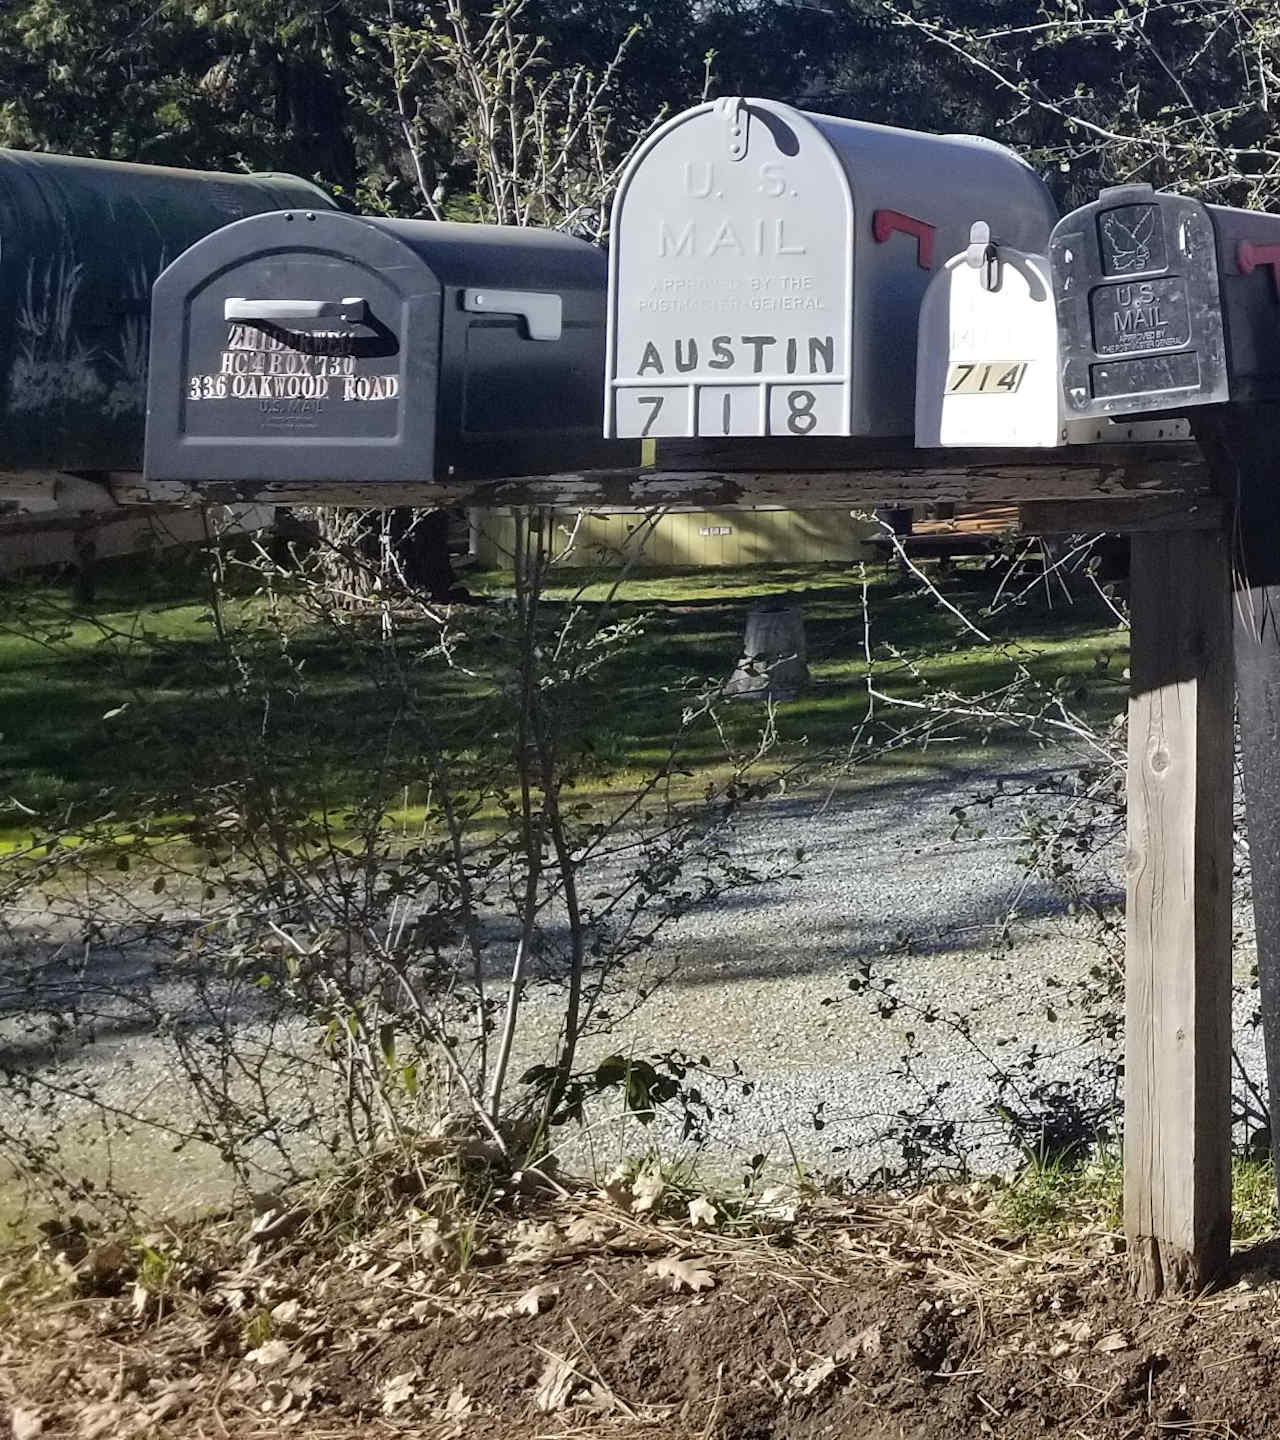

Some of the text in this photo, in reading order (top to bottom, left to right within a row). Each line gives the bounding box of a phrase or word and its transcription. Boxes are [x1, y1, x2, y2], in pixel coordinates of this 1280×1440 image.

[657, 218, 806, 258] MAIL
[1114, 308, 1168, 332] MAIL
[269, 353, 312, 376] BOX
[315, 356, 355, 377] 730
[637, 335, 834, 376] AUSTIN
[190, 375, 399, 400] 336 OAKWOOD ROAD
[952, 364, 1018, 392] 714
